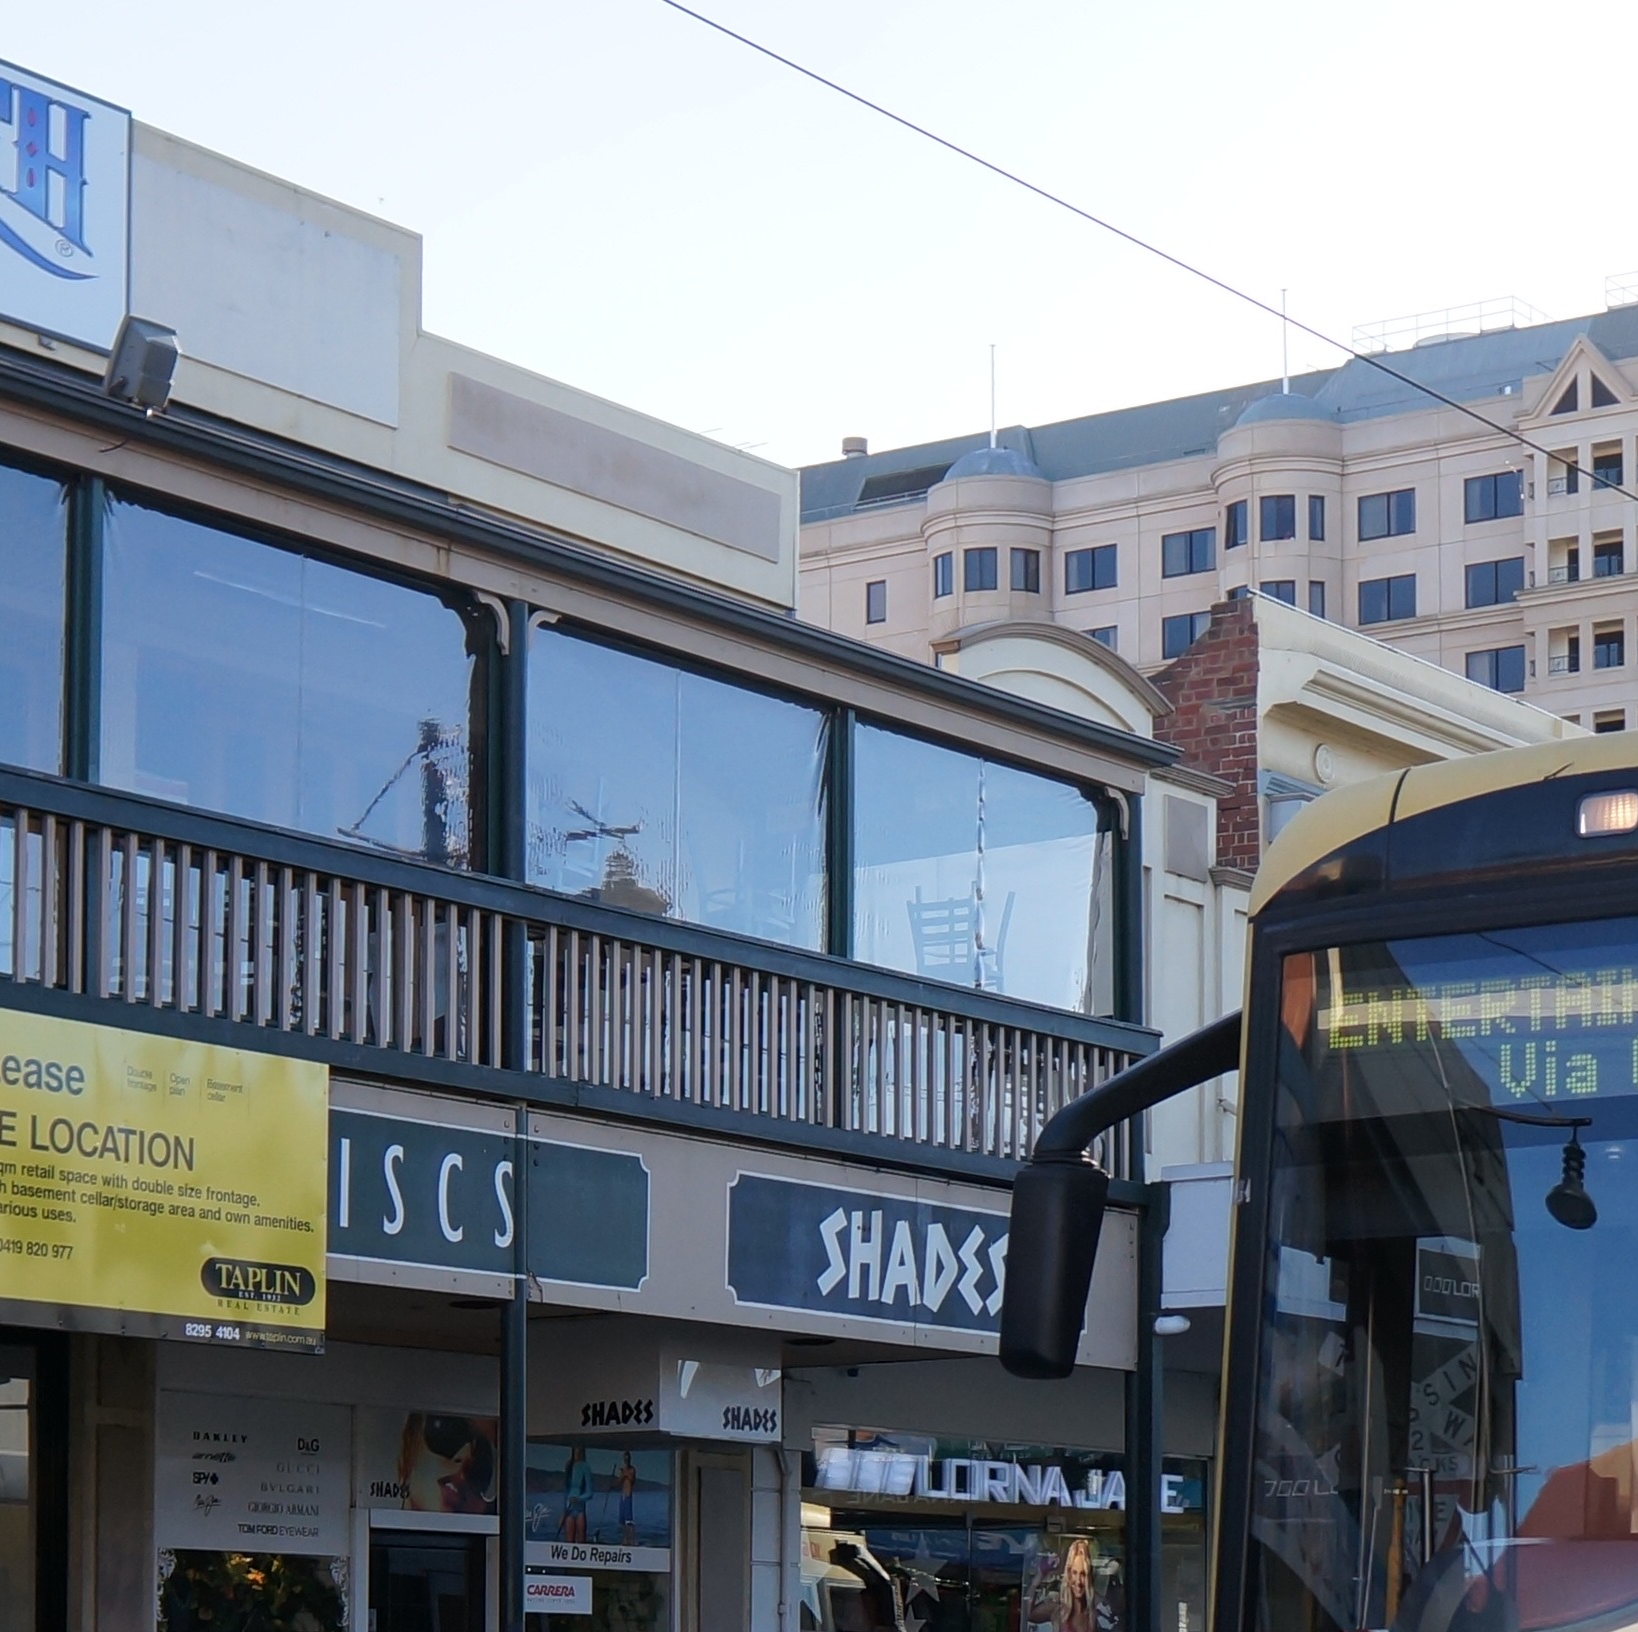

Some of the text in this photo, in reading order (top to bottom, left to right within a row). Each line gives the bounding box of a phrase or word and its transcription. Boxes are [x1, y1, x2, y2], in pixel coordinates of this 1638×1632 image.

[1499, 1037, 1599, 1099] Via
[30, 1113, 195, 1172] LOCATION
[21, 1164, 55, 1180] retail
[59, 1169, 98, 1188] space
[101, 1173, 129, 1190] with
[132, 1176, 174, 1196] double
[178, 1183, 202, 1199] size
[206, 1187, 261, 1209] frontage.
[11, 1181, 77, 1204] basement
[80, 1190, 165, 1217] cellar/storage
[168, 1204, 195, 1218] area
[199, 1206, 222, 1221] and
[225, 1211, 251, 1225] own
[254, 1213, 315, 1233] amenities.
[42, 1207, 77, 1223] uses.
[26, 1241, 49, 1258] 820
[51, 1244, 74, 1260] 977
[816, 1206, 1010, 1318] SHADES
[215, 1263, 301, 1297] TAPLIN
[217, 1298, 301, 1316] REAL ESTATE
[185, 1322, 212, 1338] 8295
[215, 1325, 241, 1340] 4104
[581, 1399, 654, 1427] SHADES
[722, 1405, 778, 1434] SHADES
[370, 1480, 411, 1499] SHADES
[920, 1454, 1185, 1514] LORNA JAE
[550, 1544, 633, 1565] We Do Repairs
[526, 1584, 576, 1598] CARRERA
